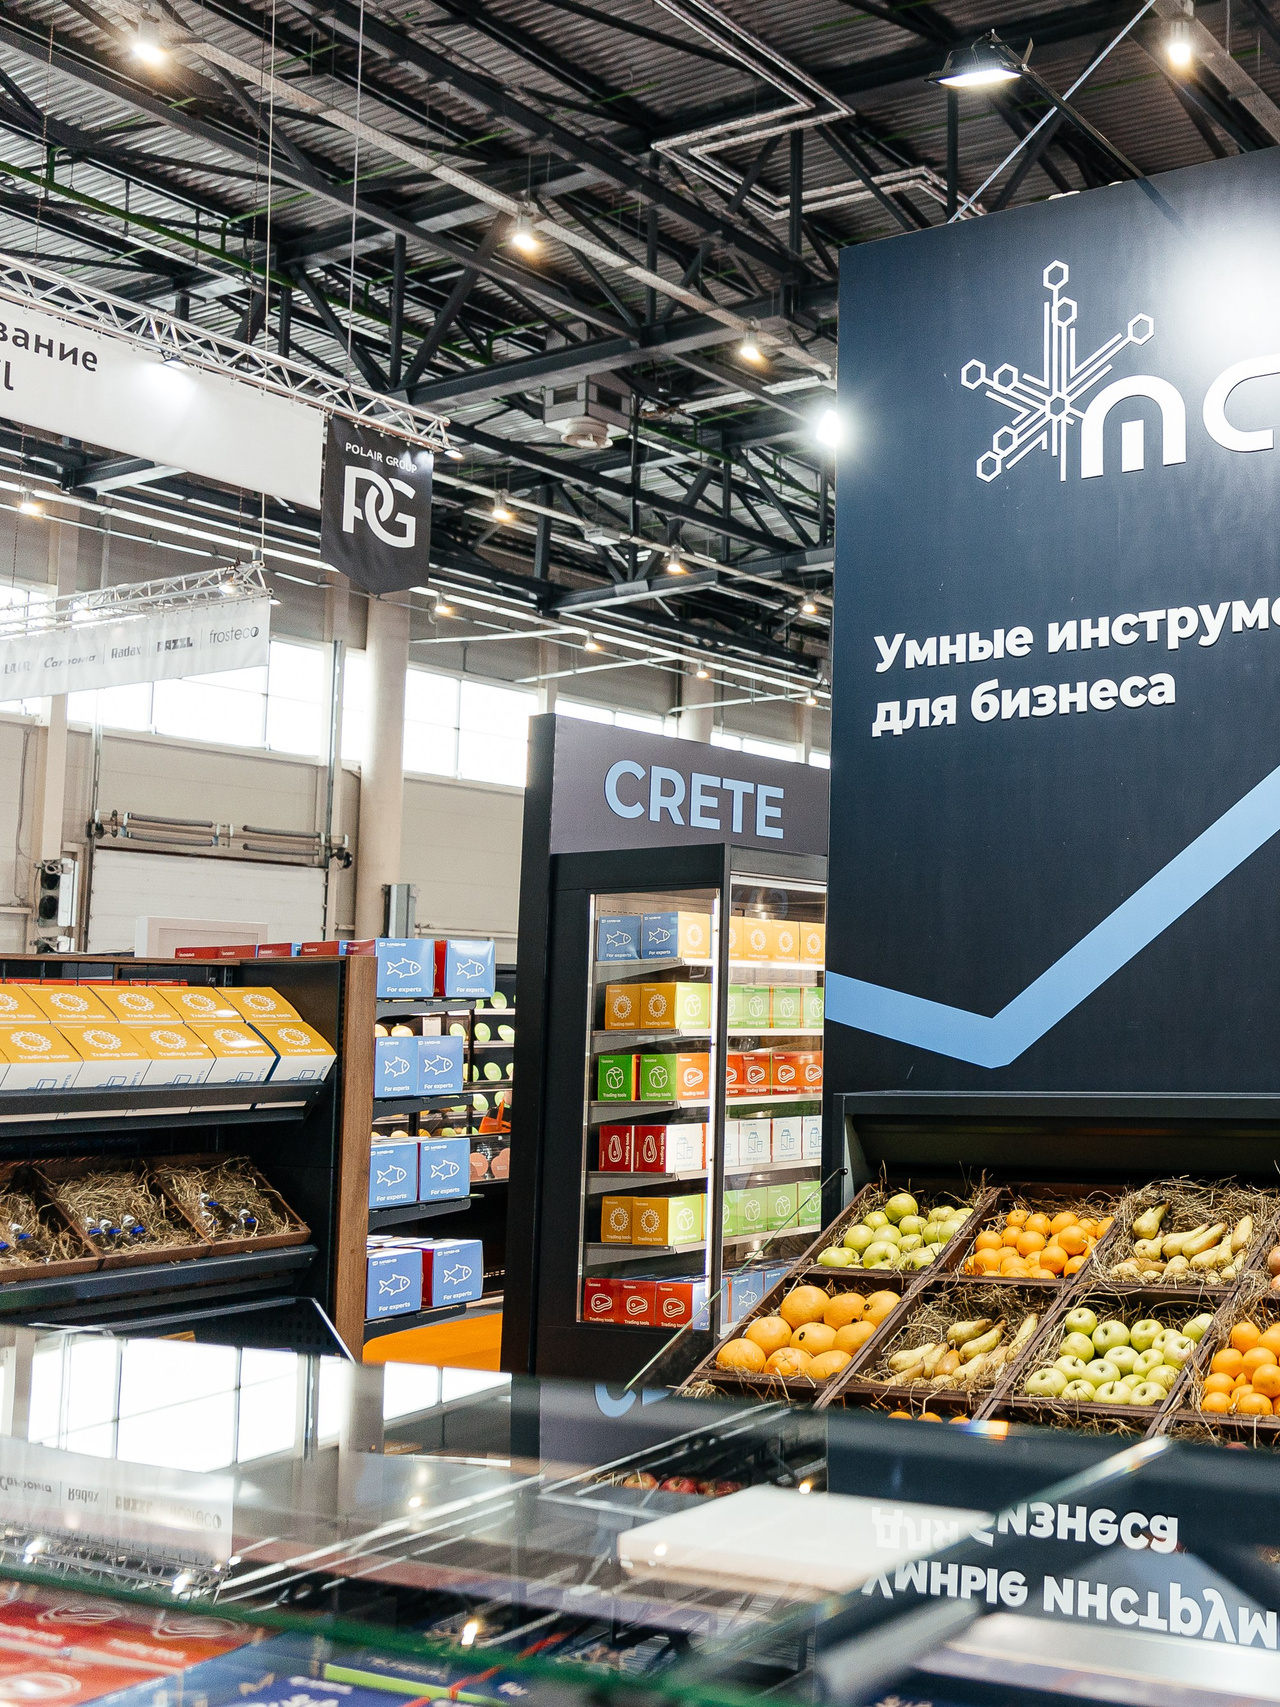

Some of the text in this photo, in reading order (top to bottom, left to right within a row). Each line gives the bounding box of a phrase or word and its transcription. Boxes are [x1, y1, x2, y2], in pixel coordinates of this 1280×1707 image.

[345, 442, 418, 473] POLAIR GROUP
[111, 645, 141, 659] Radax
[209, 626, 260, 644] frosteco
[872, 611, 1034, 675] Умные
[871, 666, 1177, 737] для бизнеса
[604, 760, 785, 839] CRETE
[389, 1302, 410, 1310] experts
[452, 1290, 472, 1299] experts
